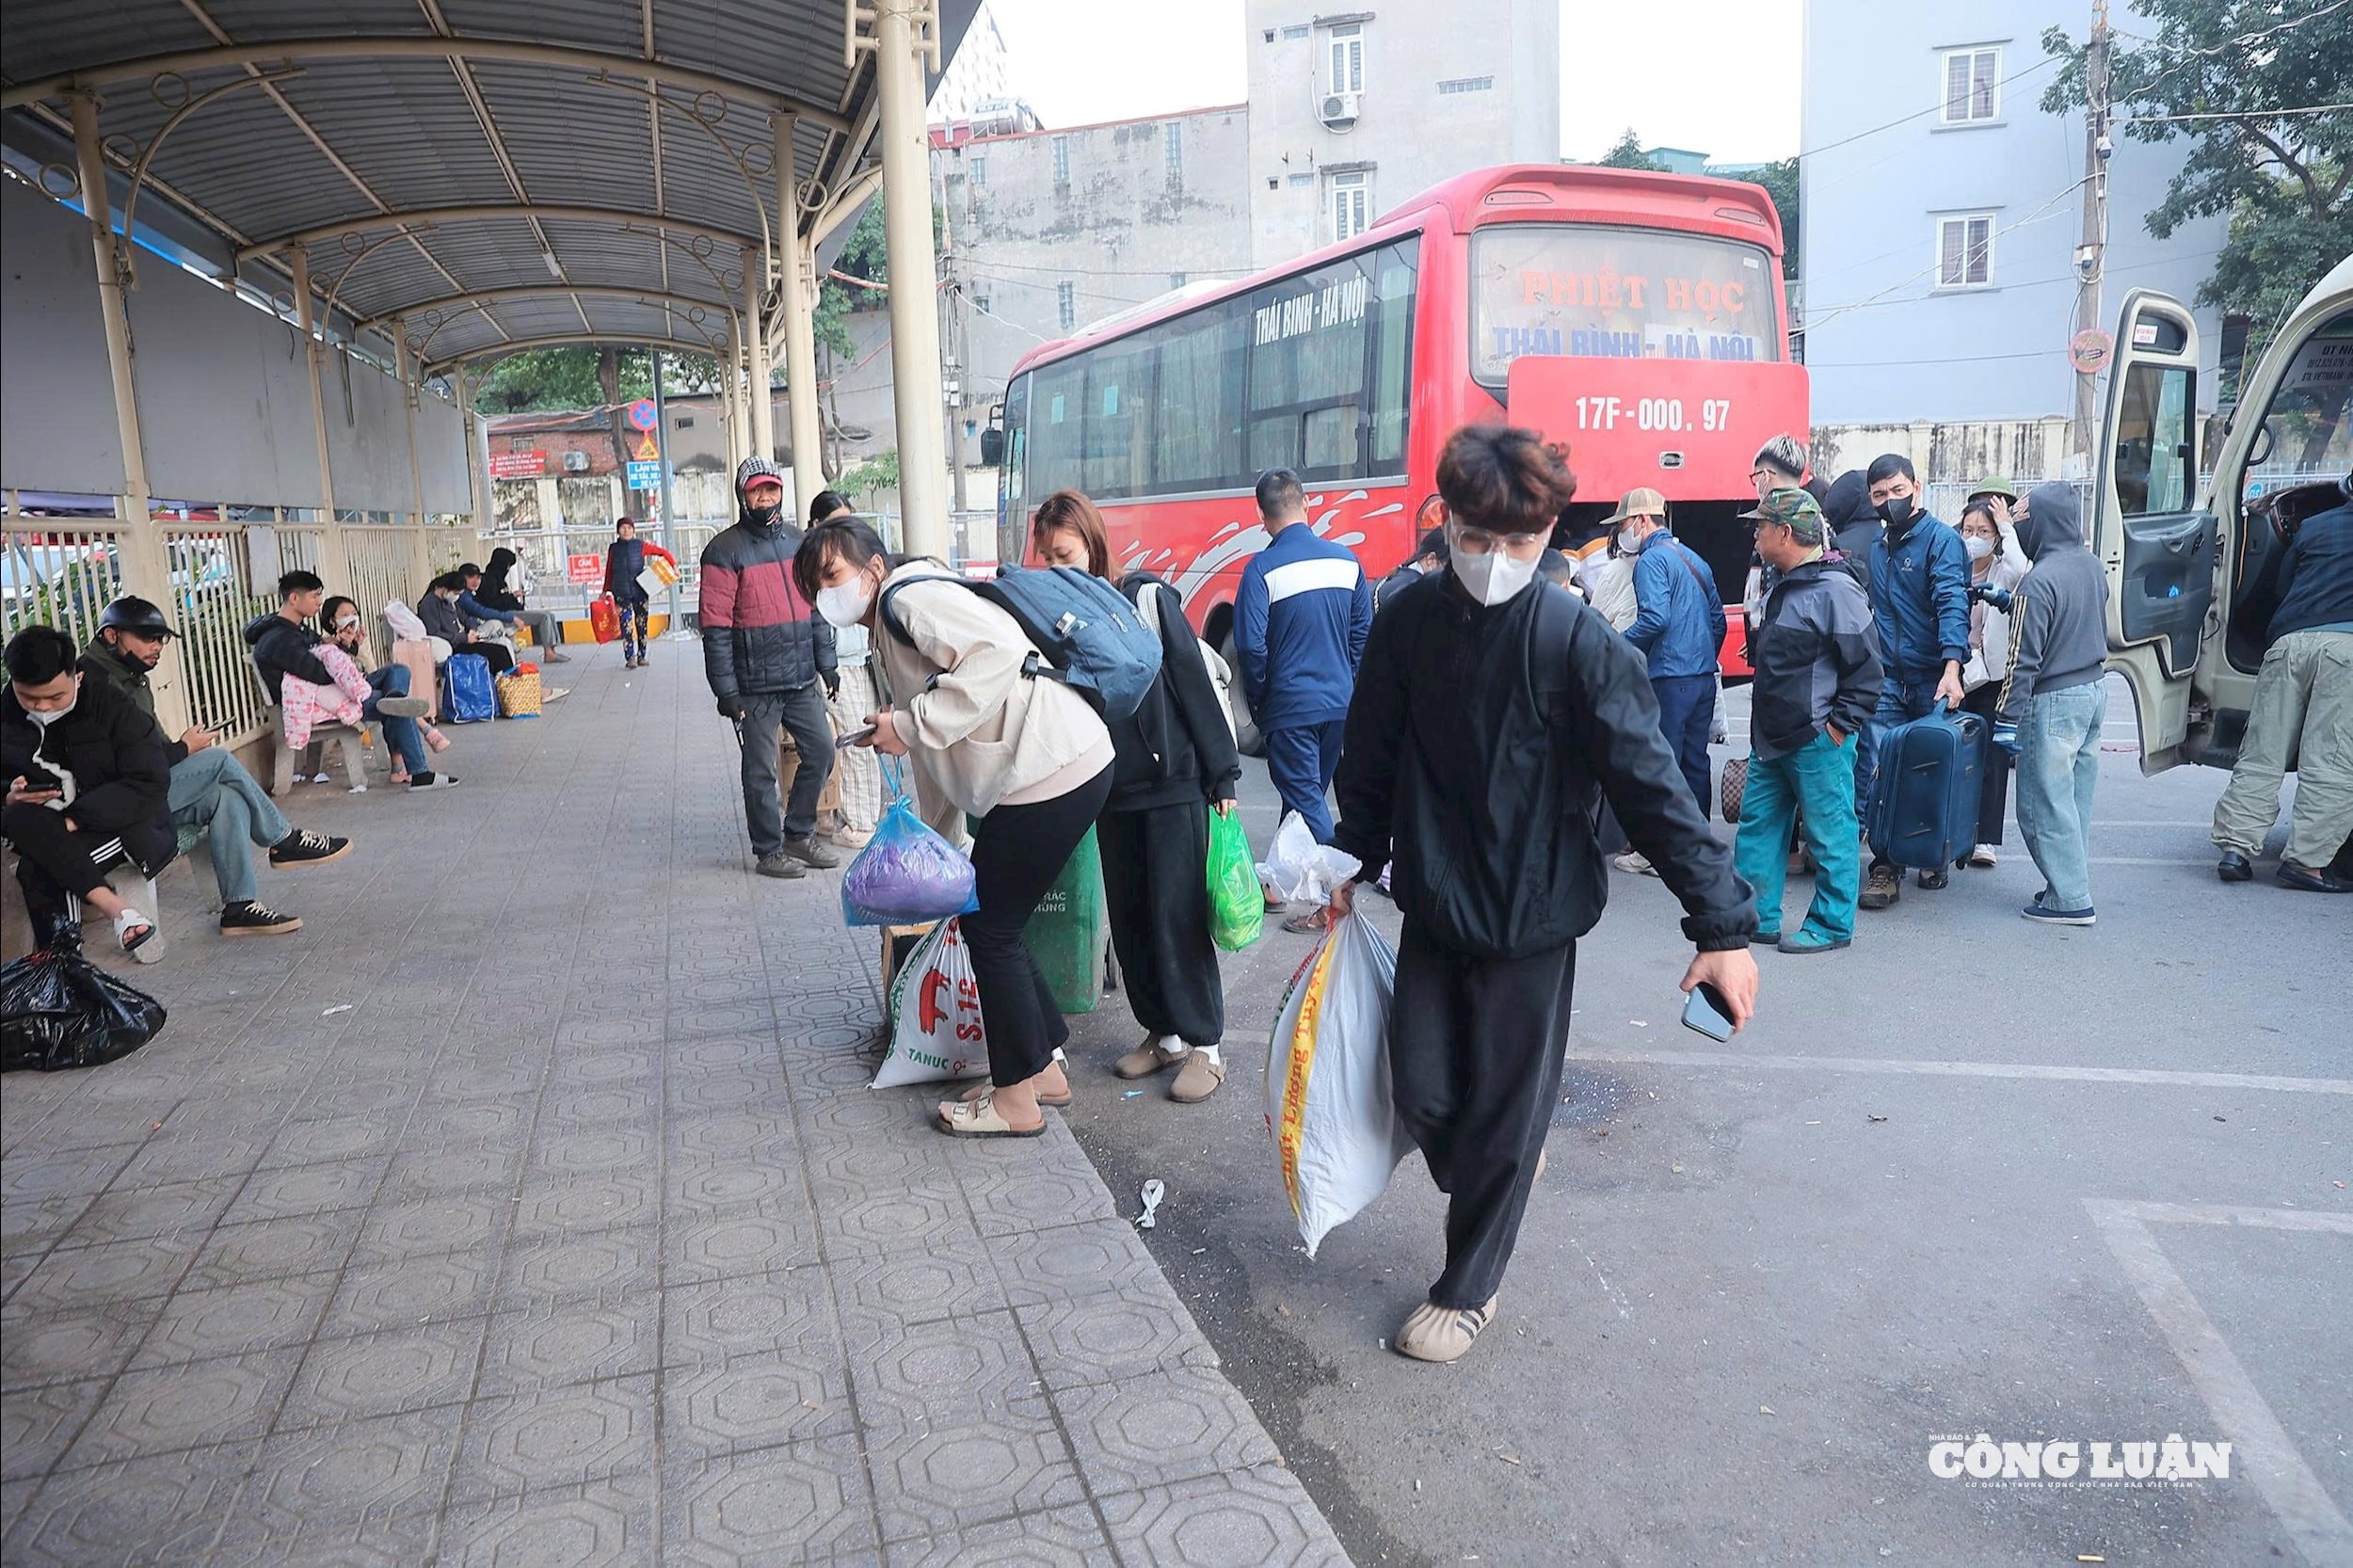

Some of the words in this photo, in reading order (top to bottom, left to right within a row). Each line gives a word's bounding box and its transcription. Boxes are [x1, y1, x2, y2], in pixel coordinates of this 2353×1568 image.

[1256, 296, 1281, 346] THÁI
[1282, 293, 1313, 339] BÌNH
[1321, 278, 1339, 328] HÀ
[1340, 269, 1367, 328] NỘI
[1519, 265, 1648, 317] PHIỆT
[1664, 277, 1745, 322] HỌC
[1492, 320, 1561, 358] THÁI
[1571, 323, 1640, 358] BÌNH
[1665, 328, 1701, 359] HÀ
